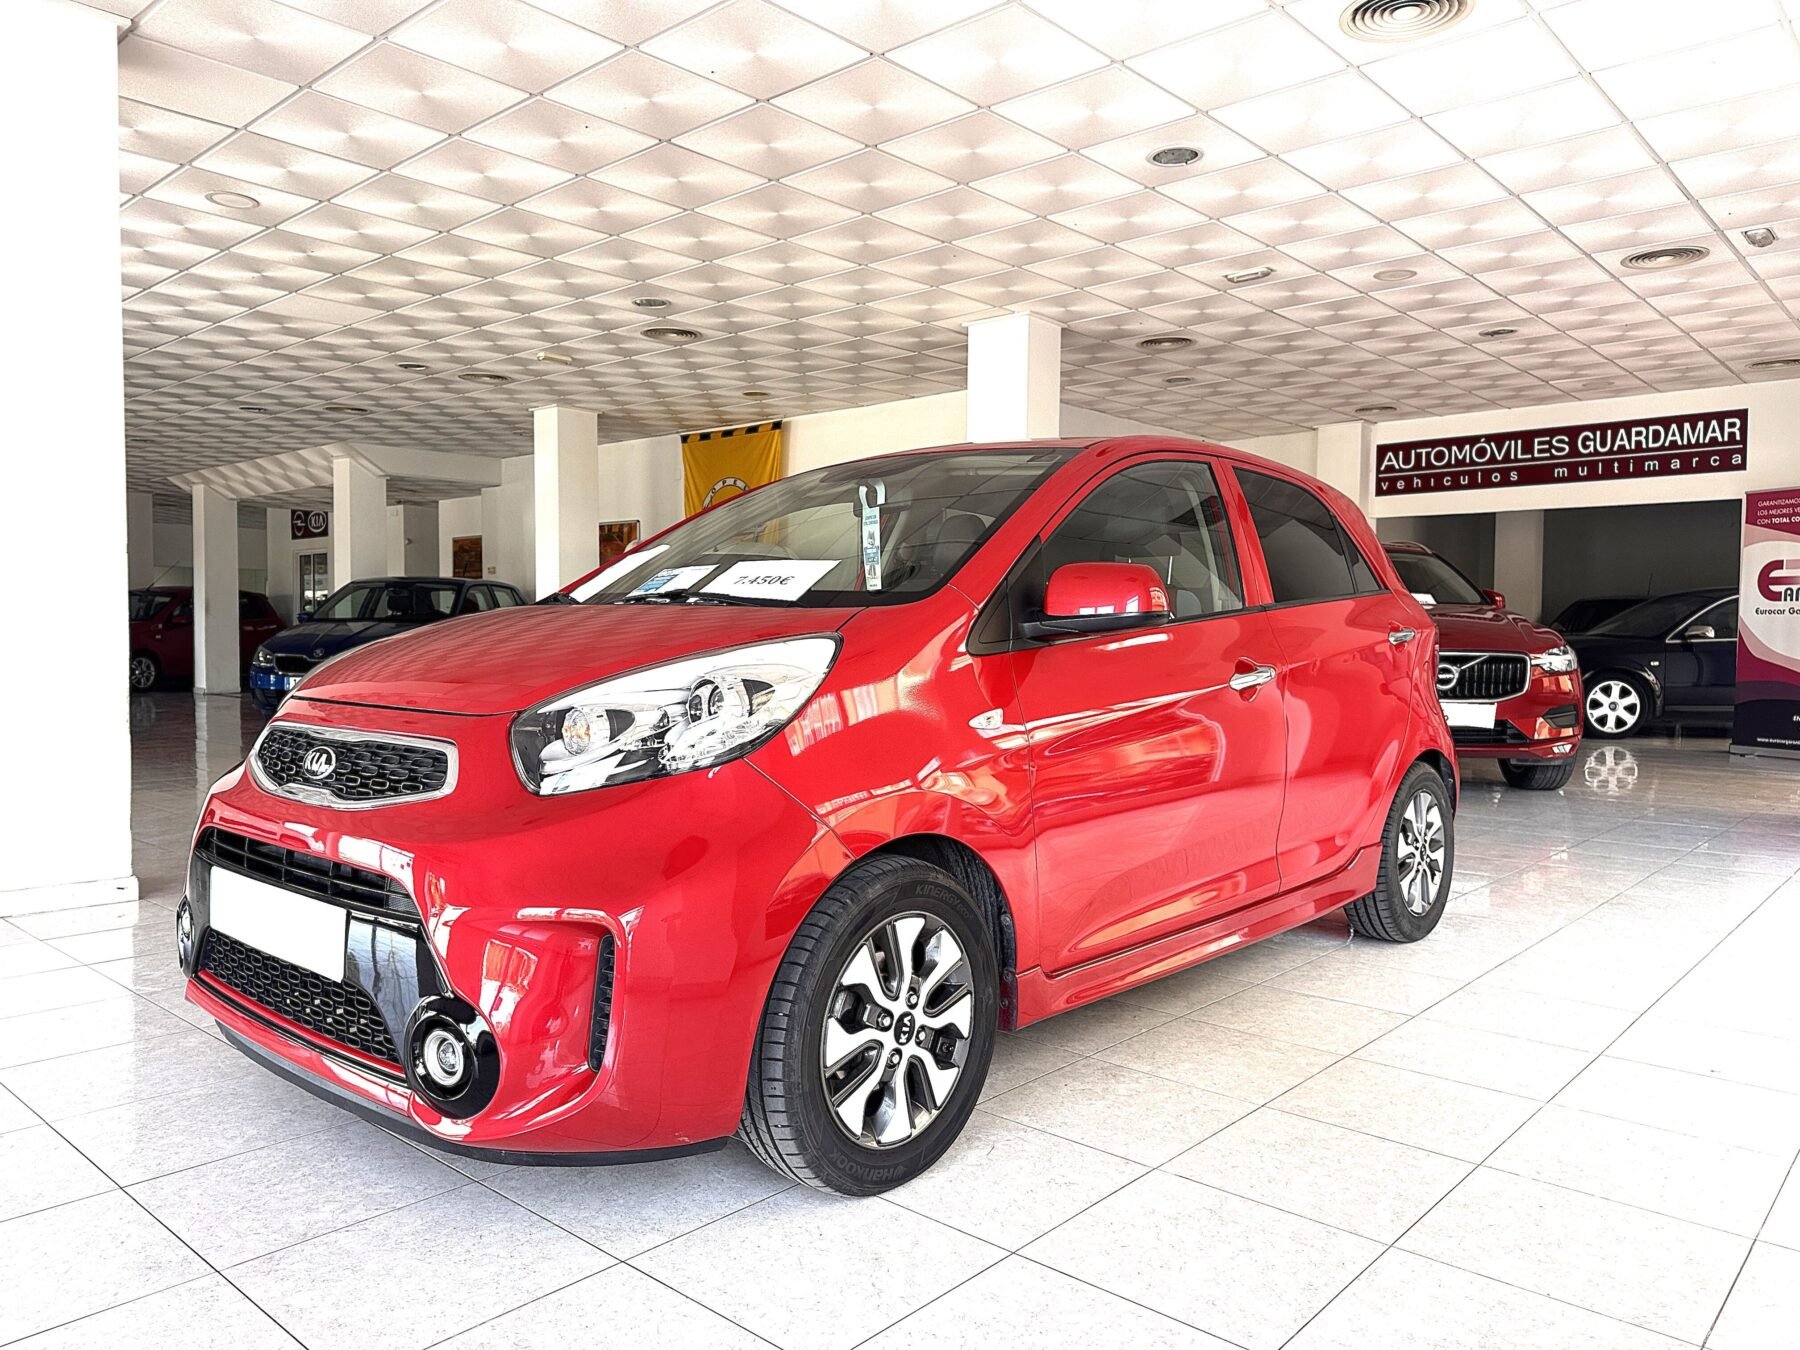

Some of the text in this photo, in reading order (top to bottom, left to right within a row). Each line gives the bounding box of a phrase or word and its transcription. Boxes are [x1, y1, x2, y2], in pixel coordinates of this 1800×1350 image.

[1380, 418, 1741, 471] AUTOMÓVILES GUARDAMAR
[1554, 454, 1742, 478] multimarca
[1771, 516, 1790, 524] TOTAL
[733, 575, 795, 585] 7.450€
[1755, 607, 1786, 615] Eurocar
[898, 1015, 912, 1043] KIA
